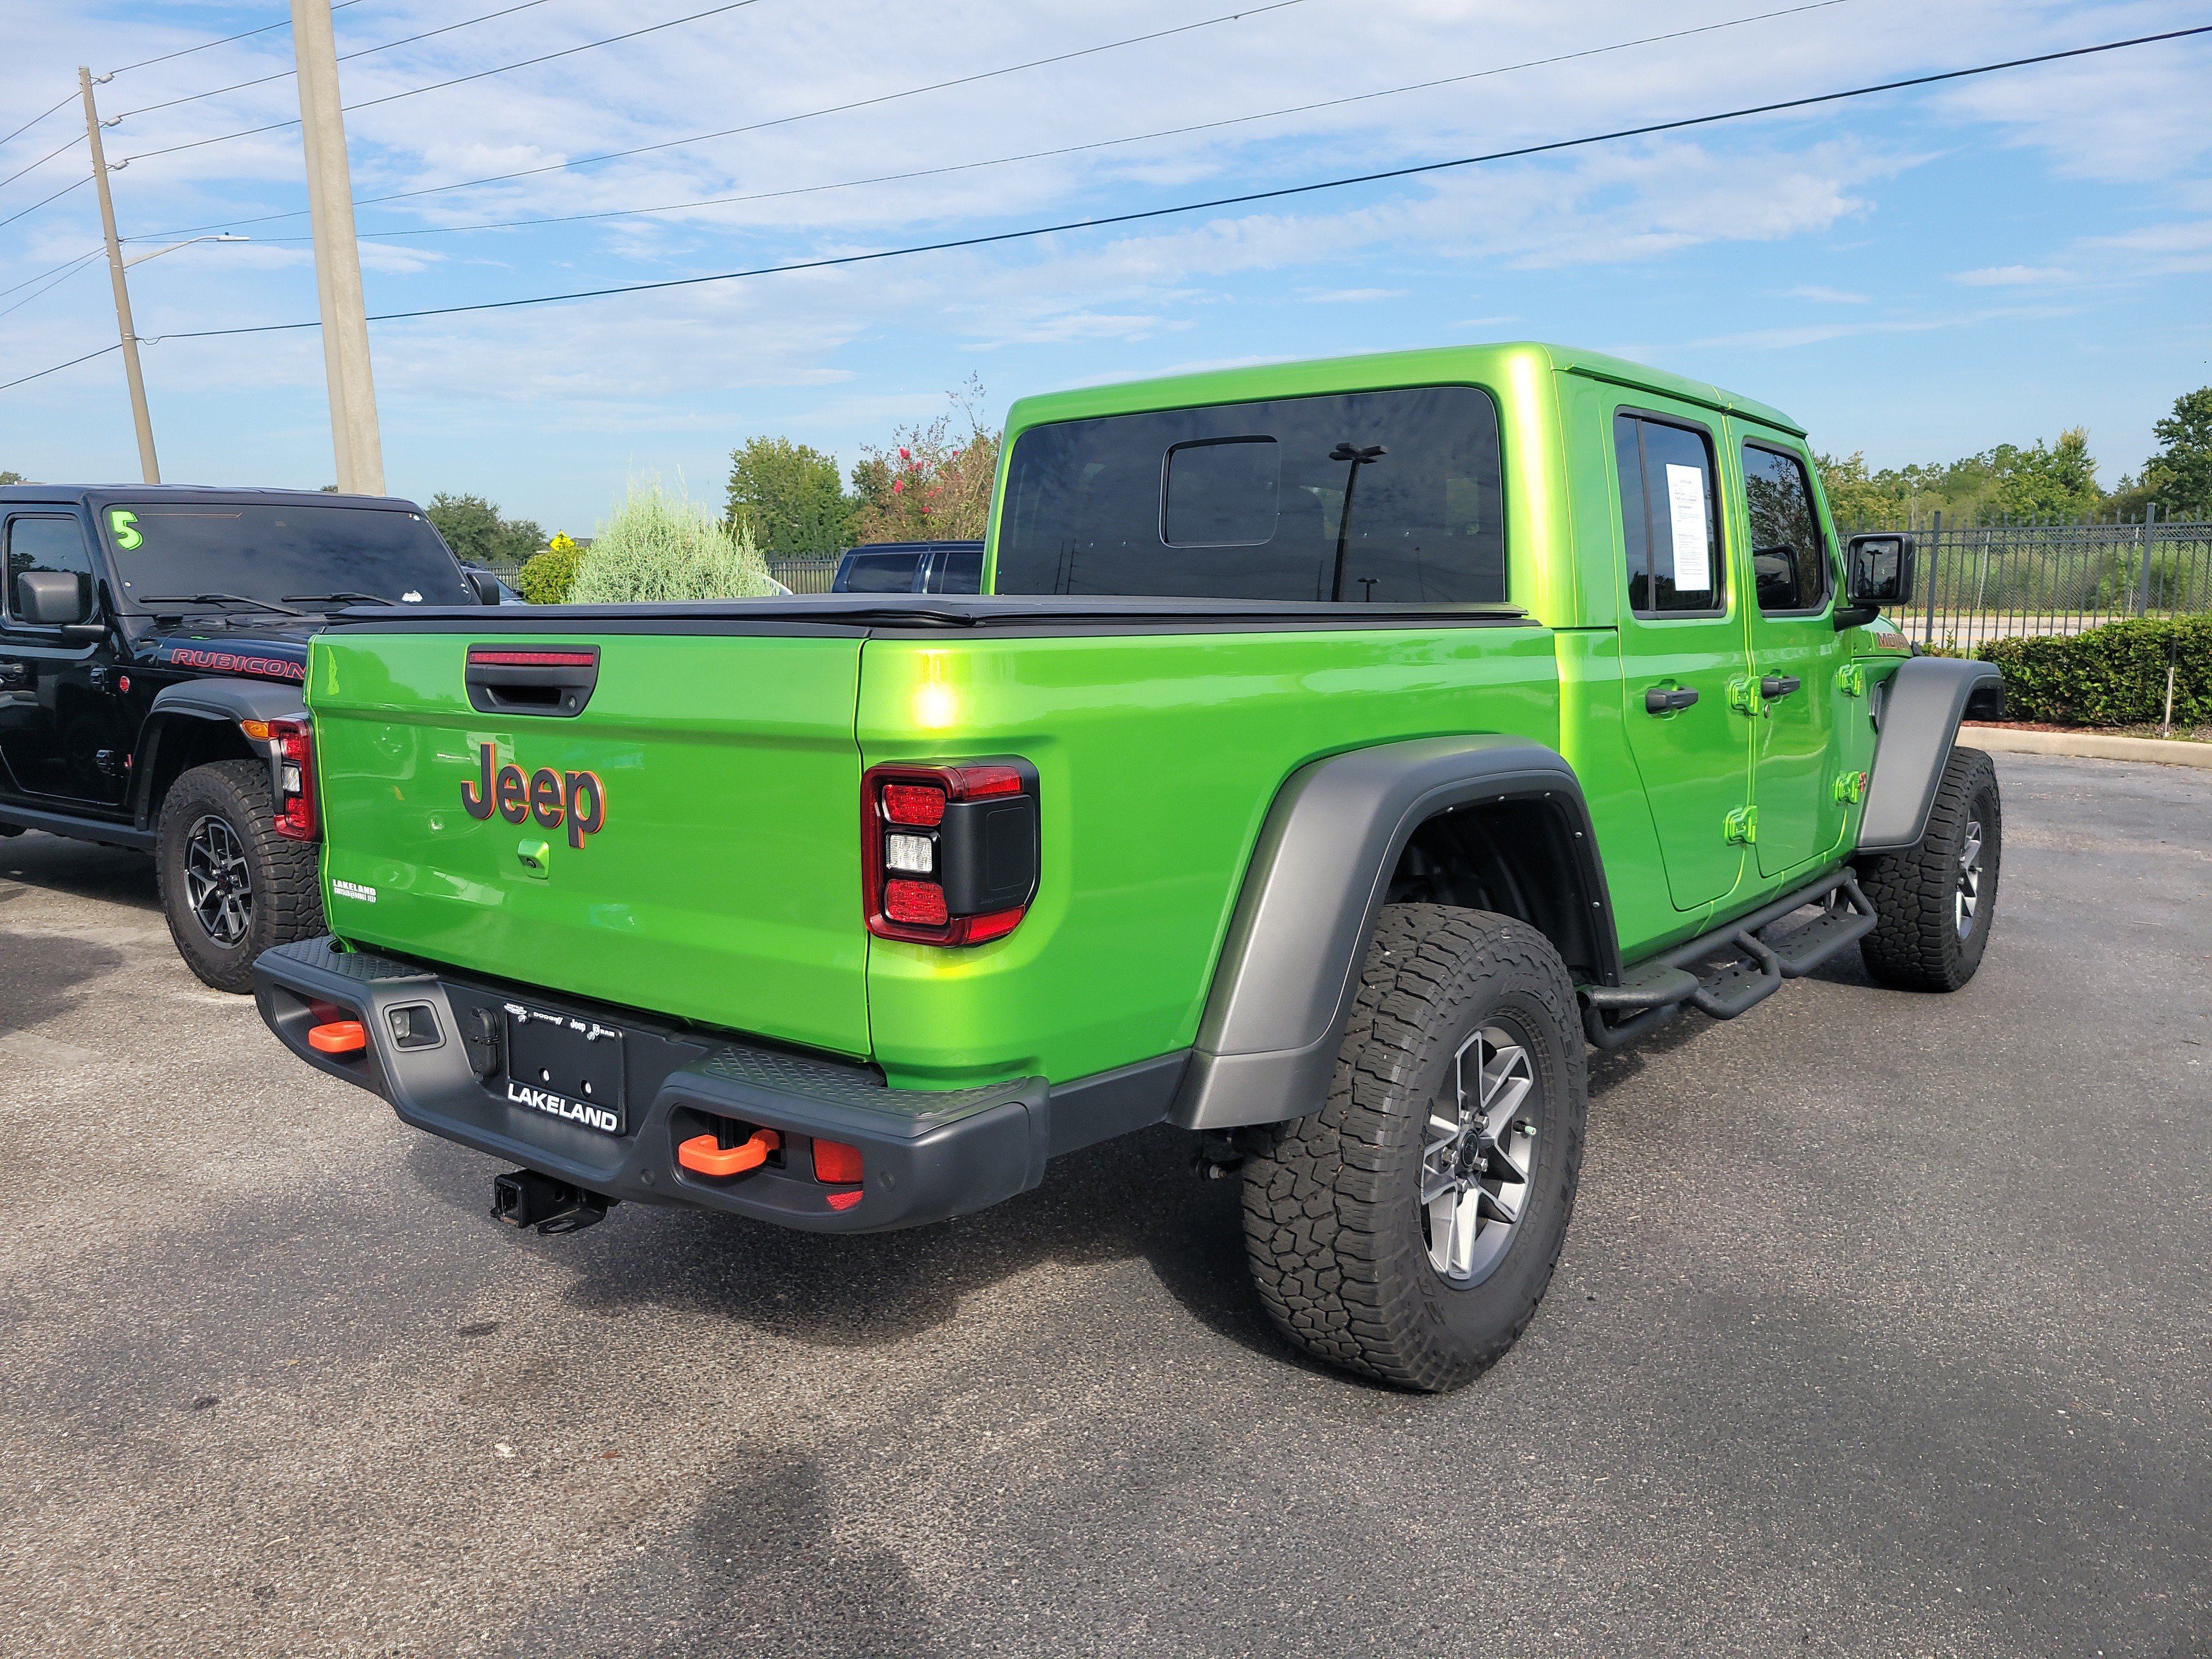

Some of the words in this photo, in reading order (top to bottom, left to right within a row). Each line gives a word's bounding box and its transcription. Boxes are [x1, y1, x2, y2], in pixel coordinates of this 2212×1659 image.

[111, 510, 144, 551] 5
[171, 648, 306, 680] RUBICON
[461, 742, 604, 849] Jeep
[332, 878, 376, 895] LAKELAND
[571, 1019, 586, 1032] Jeep
[600, 1029, 615, 1037] RAM
[508, 1083, 617, 1131] LAKELAND
